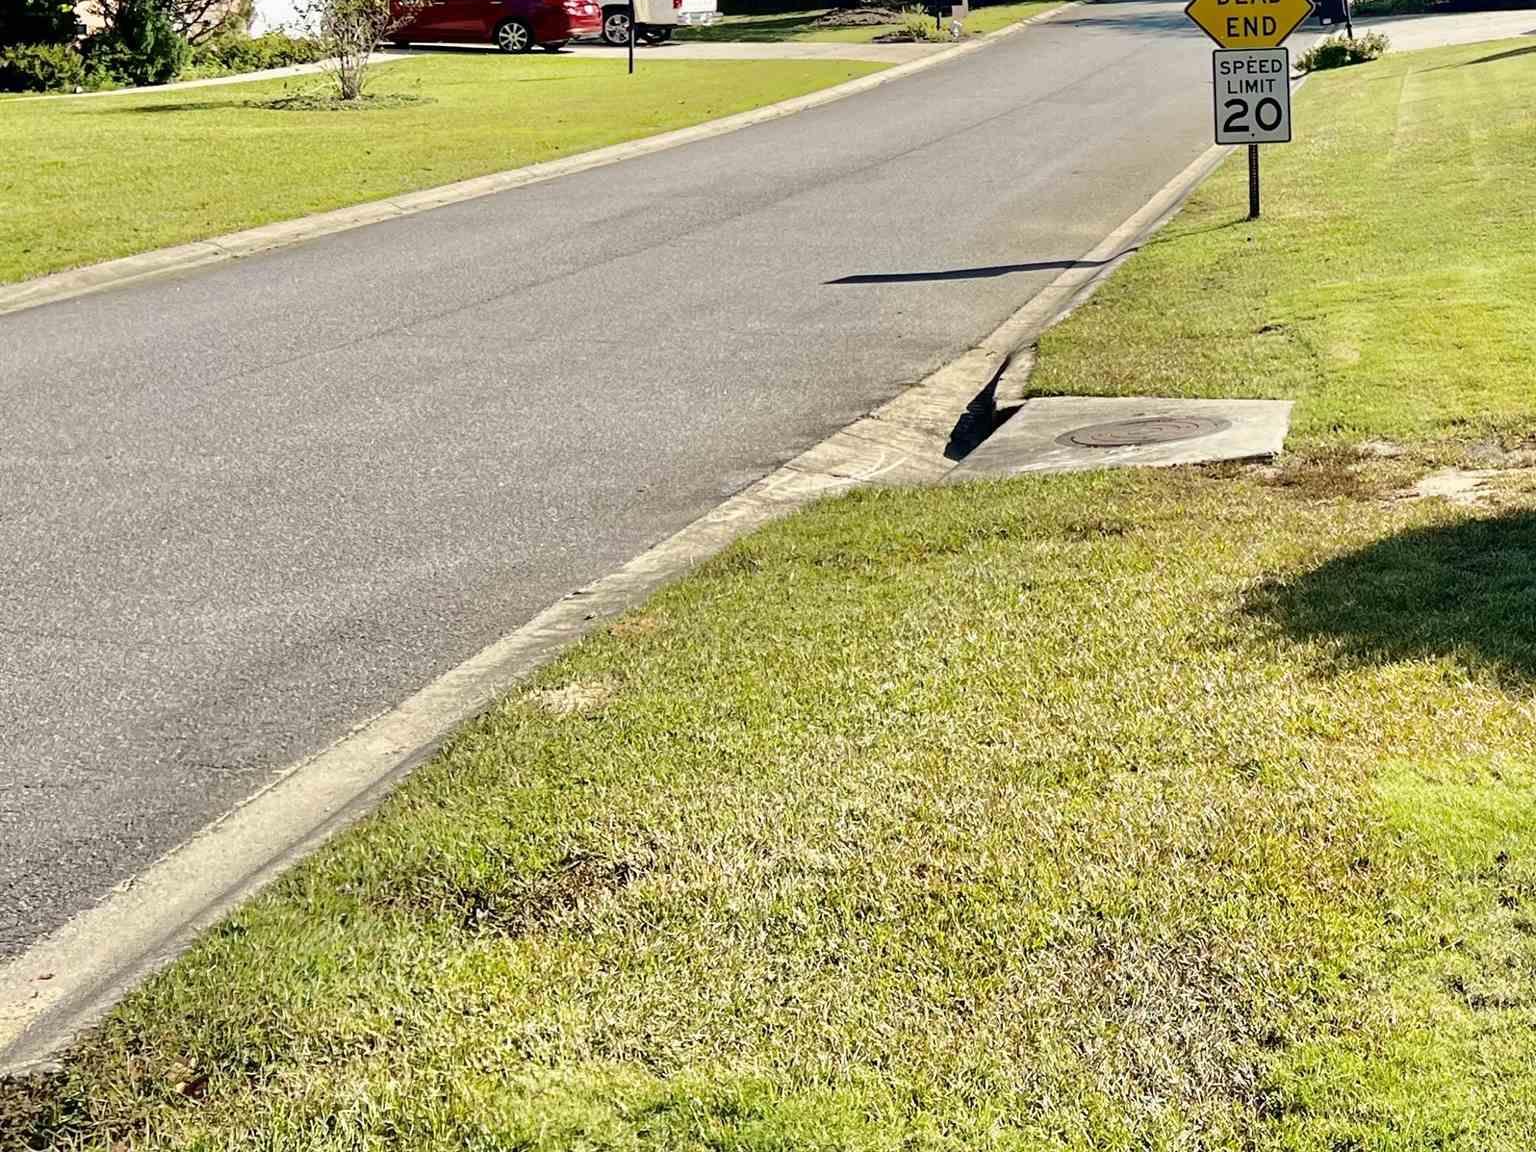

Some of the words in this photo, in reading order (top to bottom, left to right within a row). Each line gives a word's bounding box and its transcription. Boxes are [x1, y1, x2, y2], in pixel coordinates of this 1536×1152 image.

[1226, 16, 1277, 37] END
[1220, 59, 1282, 75] SPEED
[1227, 79, 1275, 94] LIMIT
[1223, 97, 1282, 133] 20
